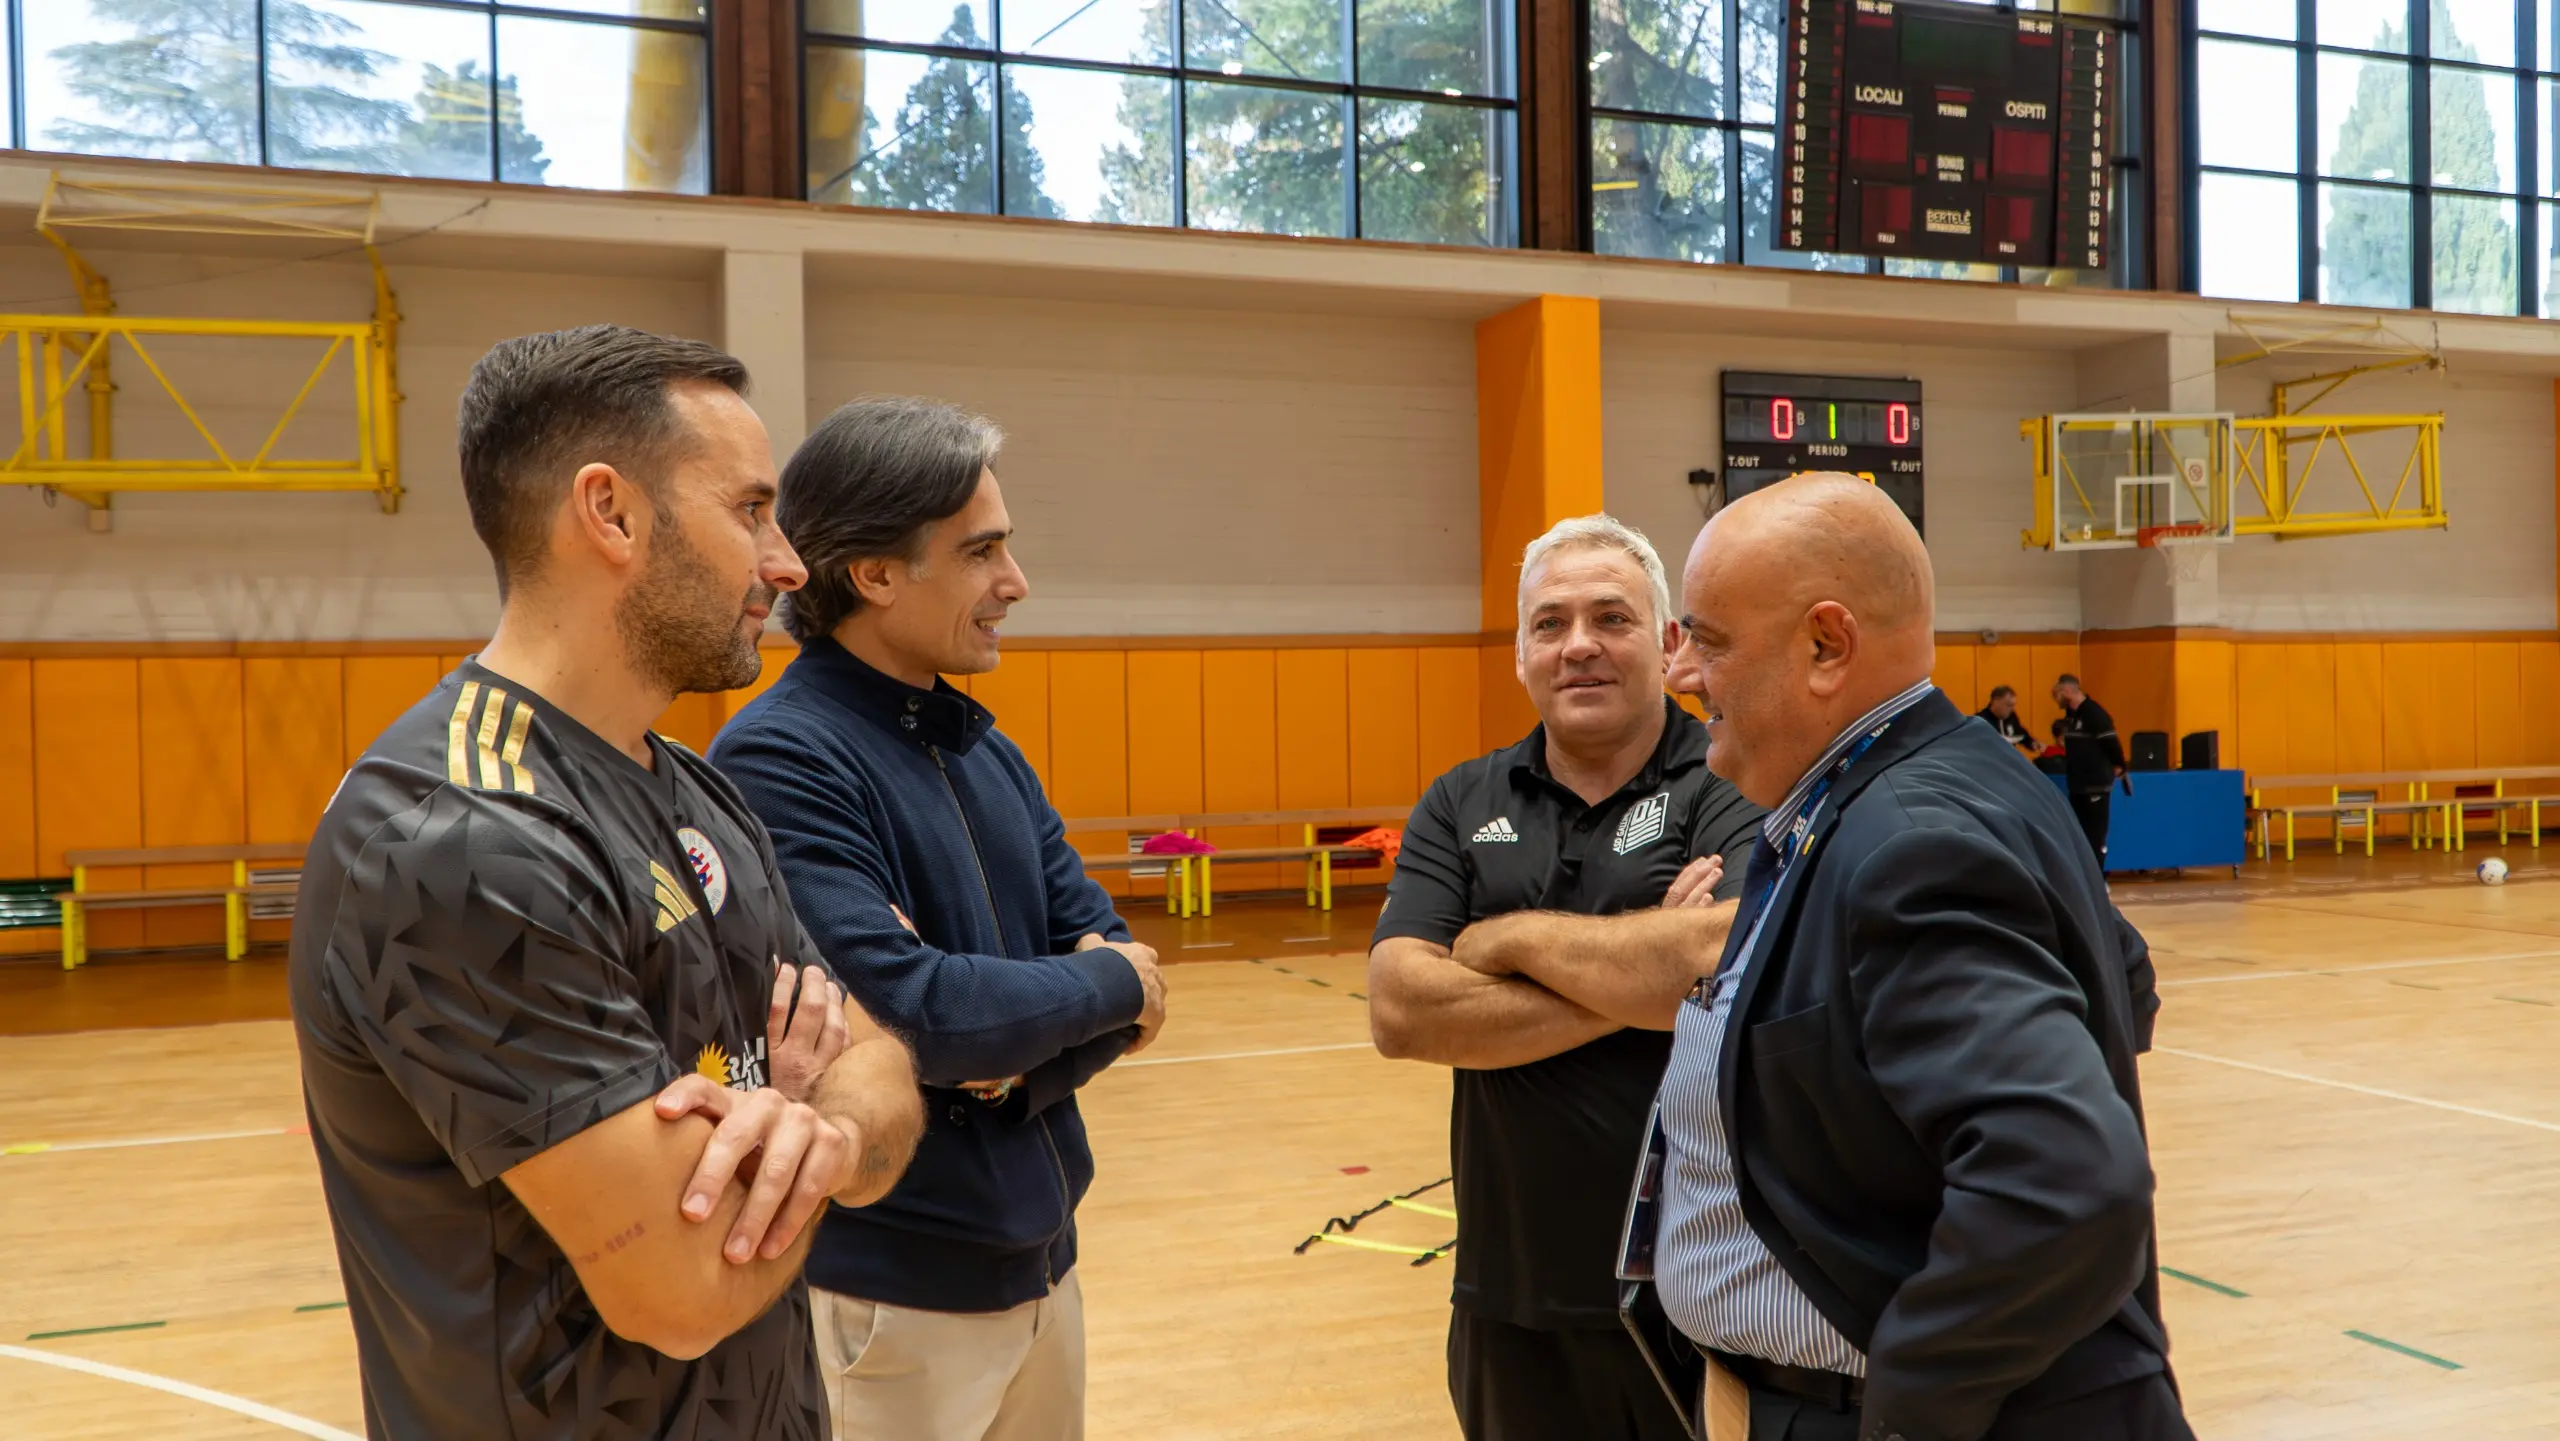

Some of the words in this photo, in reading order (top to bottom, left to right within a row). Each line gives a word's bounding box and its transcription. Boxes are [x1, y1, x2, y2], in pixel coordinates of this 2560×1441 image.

[1856, 0, 1894, 14] TIME-OUT
[1801, 17, 1808, 34] 5
[2019, 19, 2053, 34] TIME-OUT
[1800, 38, 1807, 55] 6
[2096, 31, 2103, 47] 4
[2097, 50, 2103, 68] 5
[1800, 60, 1806, 76] 7
[2095, 71, 2102, 87] 6
[1798, 82, 1806, 98] 8
[1856, 86, 1903, 105] LOCALI
[2096, 90, 2101, 107] 7
[1797, 102, 1805, 119] 9
[2006, 101, 2046, 119] OSPITI
[2094, 111, 2101, 127] 8
[1795, 124, 1806, 141] 10
[2094, 131, 2100, 147] 9
[1794, 144, 1804, 161] 11
[2092, 151, 2101, 167] 10
[1793, 166, 1804, 183] 12
[2091, 171, 2100, 187] 11
[1792, 187, 1803, 204] 13
[2090, 191, 2100, 207] 12
[1792, 209, 1802, 225] 14
[2089, 211, 2100, 226] 13
[1791, 230, 1801, 246] 15
[2089, 231, 2098, 246] 14
[2088, 251, 2098, 266] 15
[1772, 398, 1793, 440] 0
[1797, 412, 1805, 426] B
[1829, 403, 1836, 440] 1
[1888, 403, 1909, 444] 0
[1912, 417, 1920, 431] B
[1808, 445, 1848, 457] PERIOD
[1728, 456, 1760, 468] T.OUT
[1891, 461, 1922, 473] T.OUT
[1472, 831, 1518, 843] adidas
